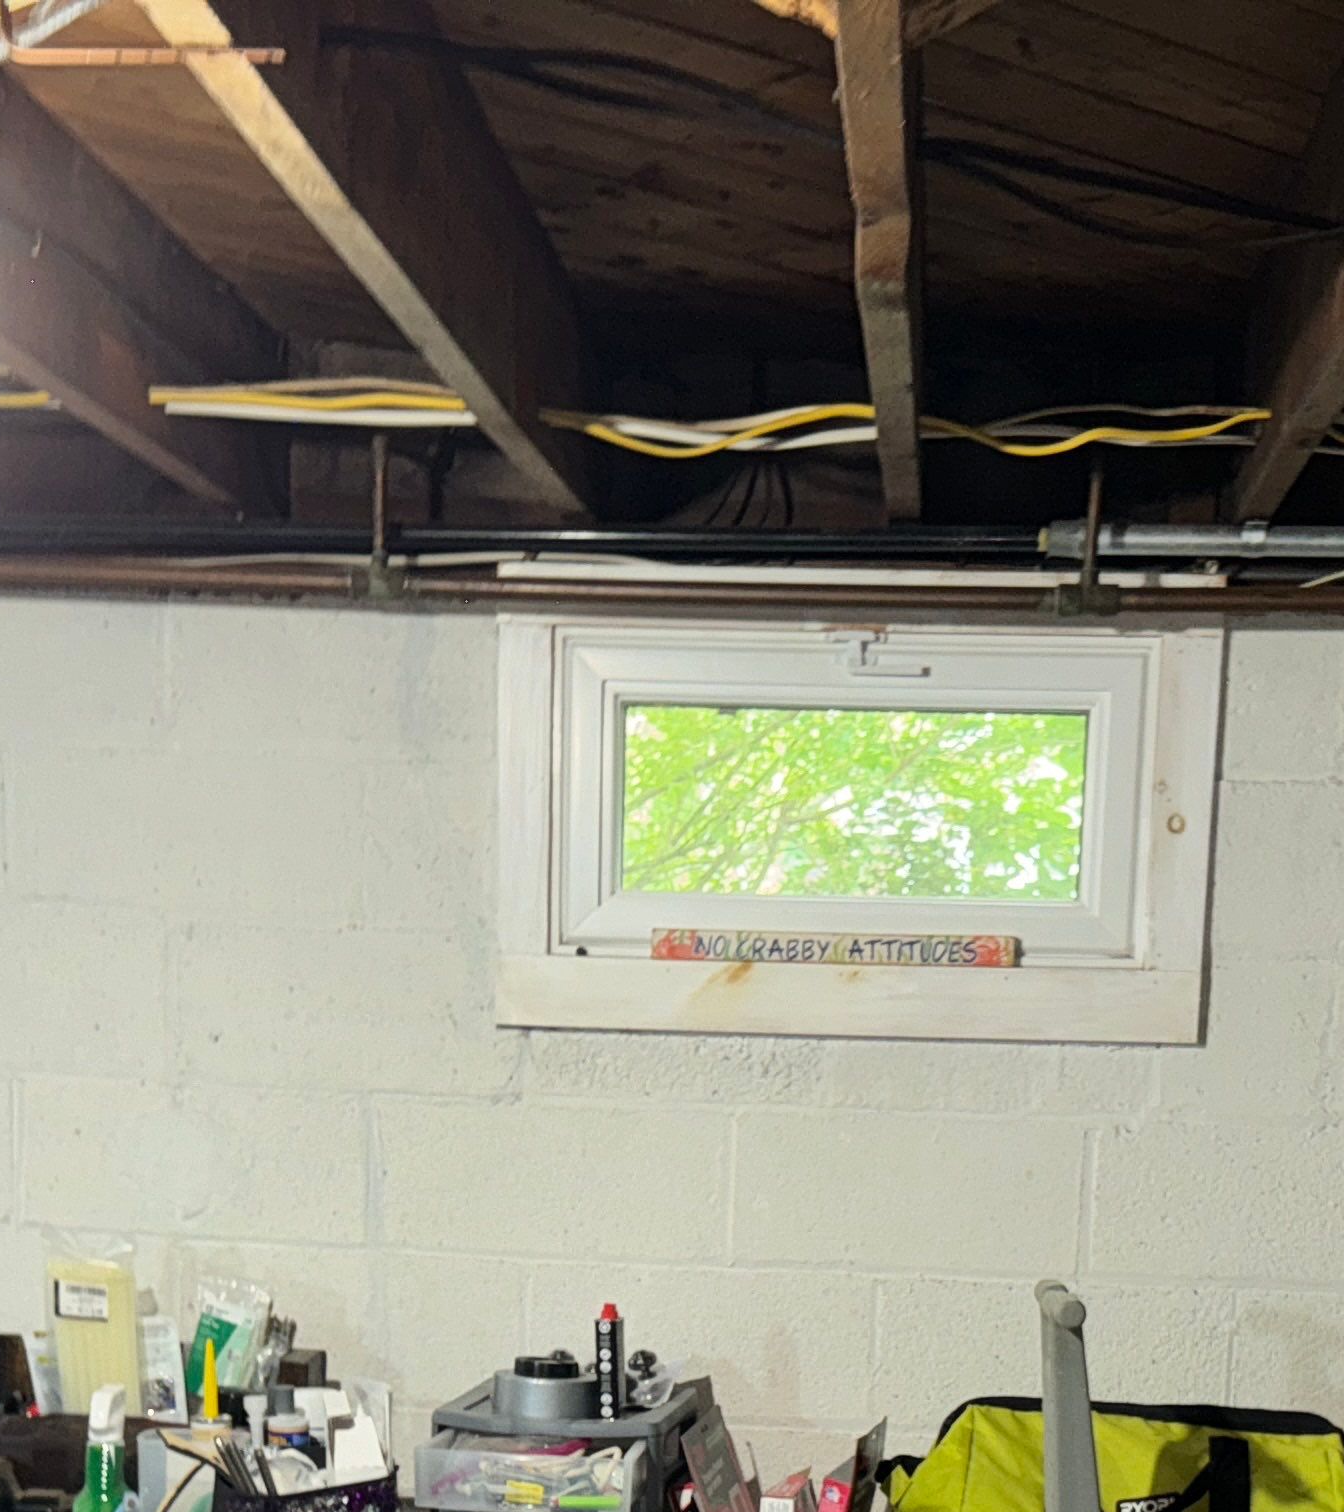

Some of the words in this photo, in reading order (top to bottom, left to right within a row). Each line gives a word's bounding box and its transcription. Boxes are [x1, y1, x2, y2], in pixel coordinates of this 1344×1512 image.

[694, 935, 725, 958] NO
[736, 935, 829, 962] CRABBY
[848, 938, 980, 964] ATTITUDES
